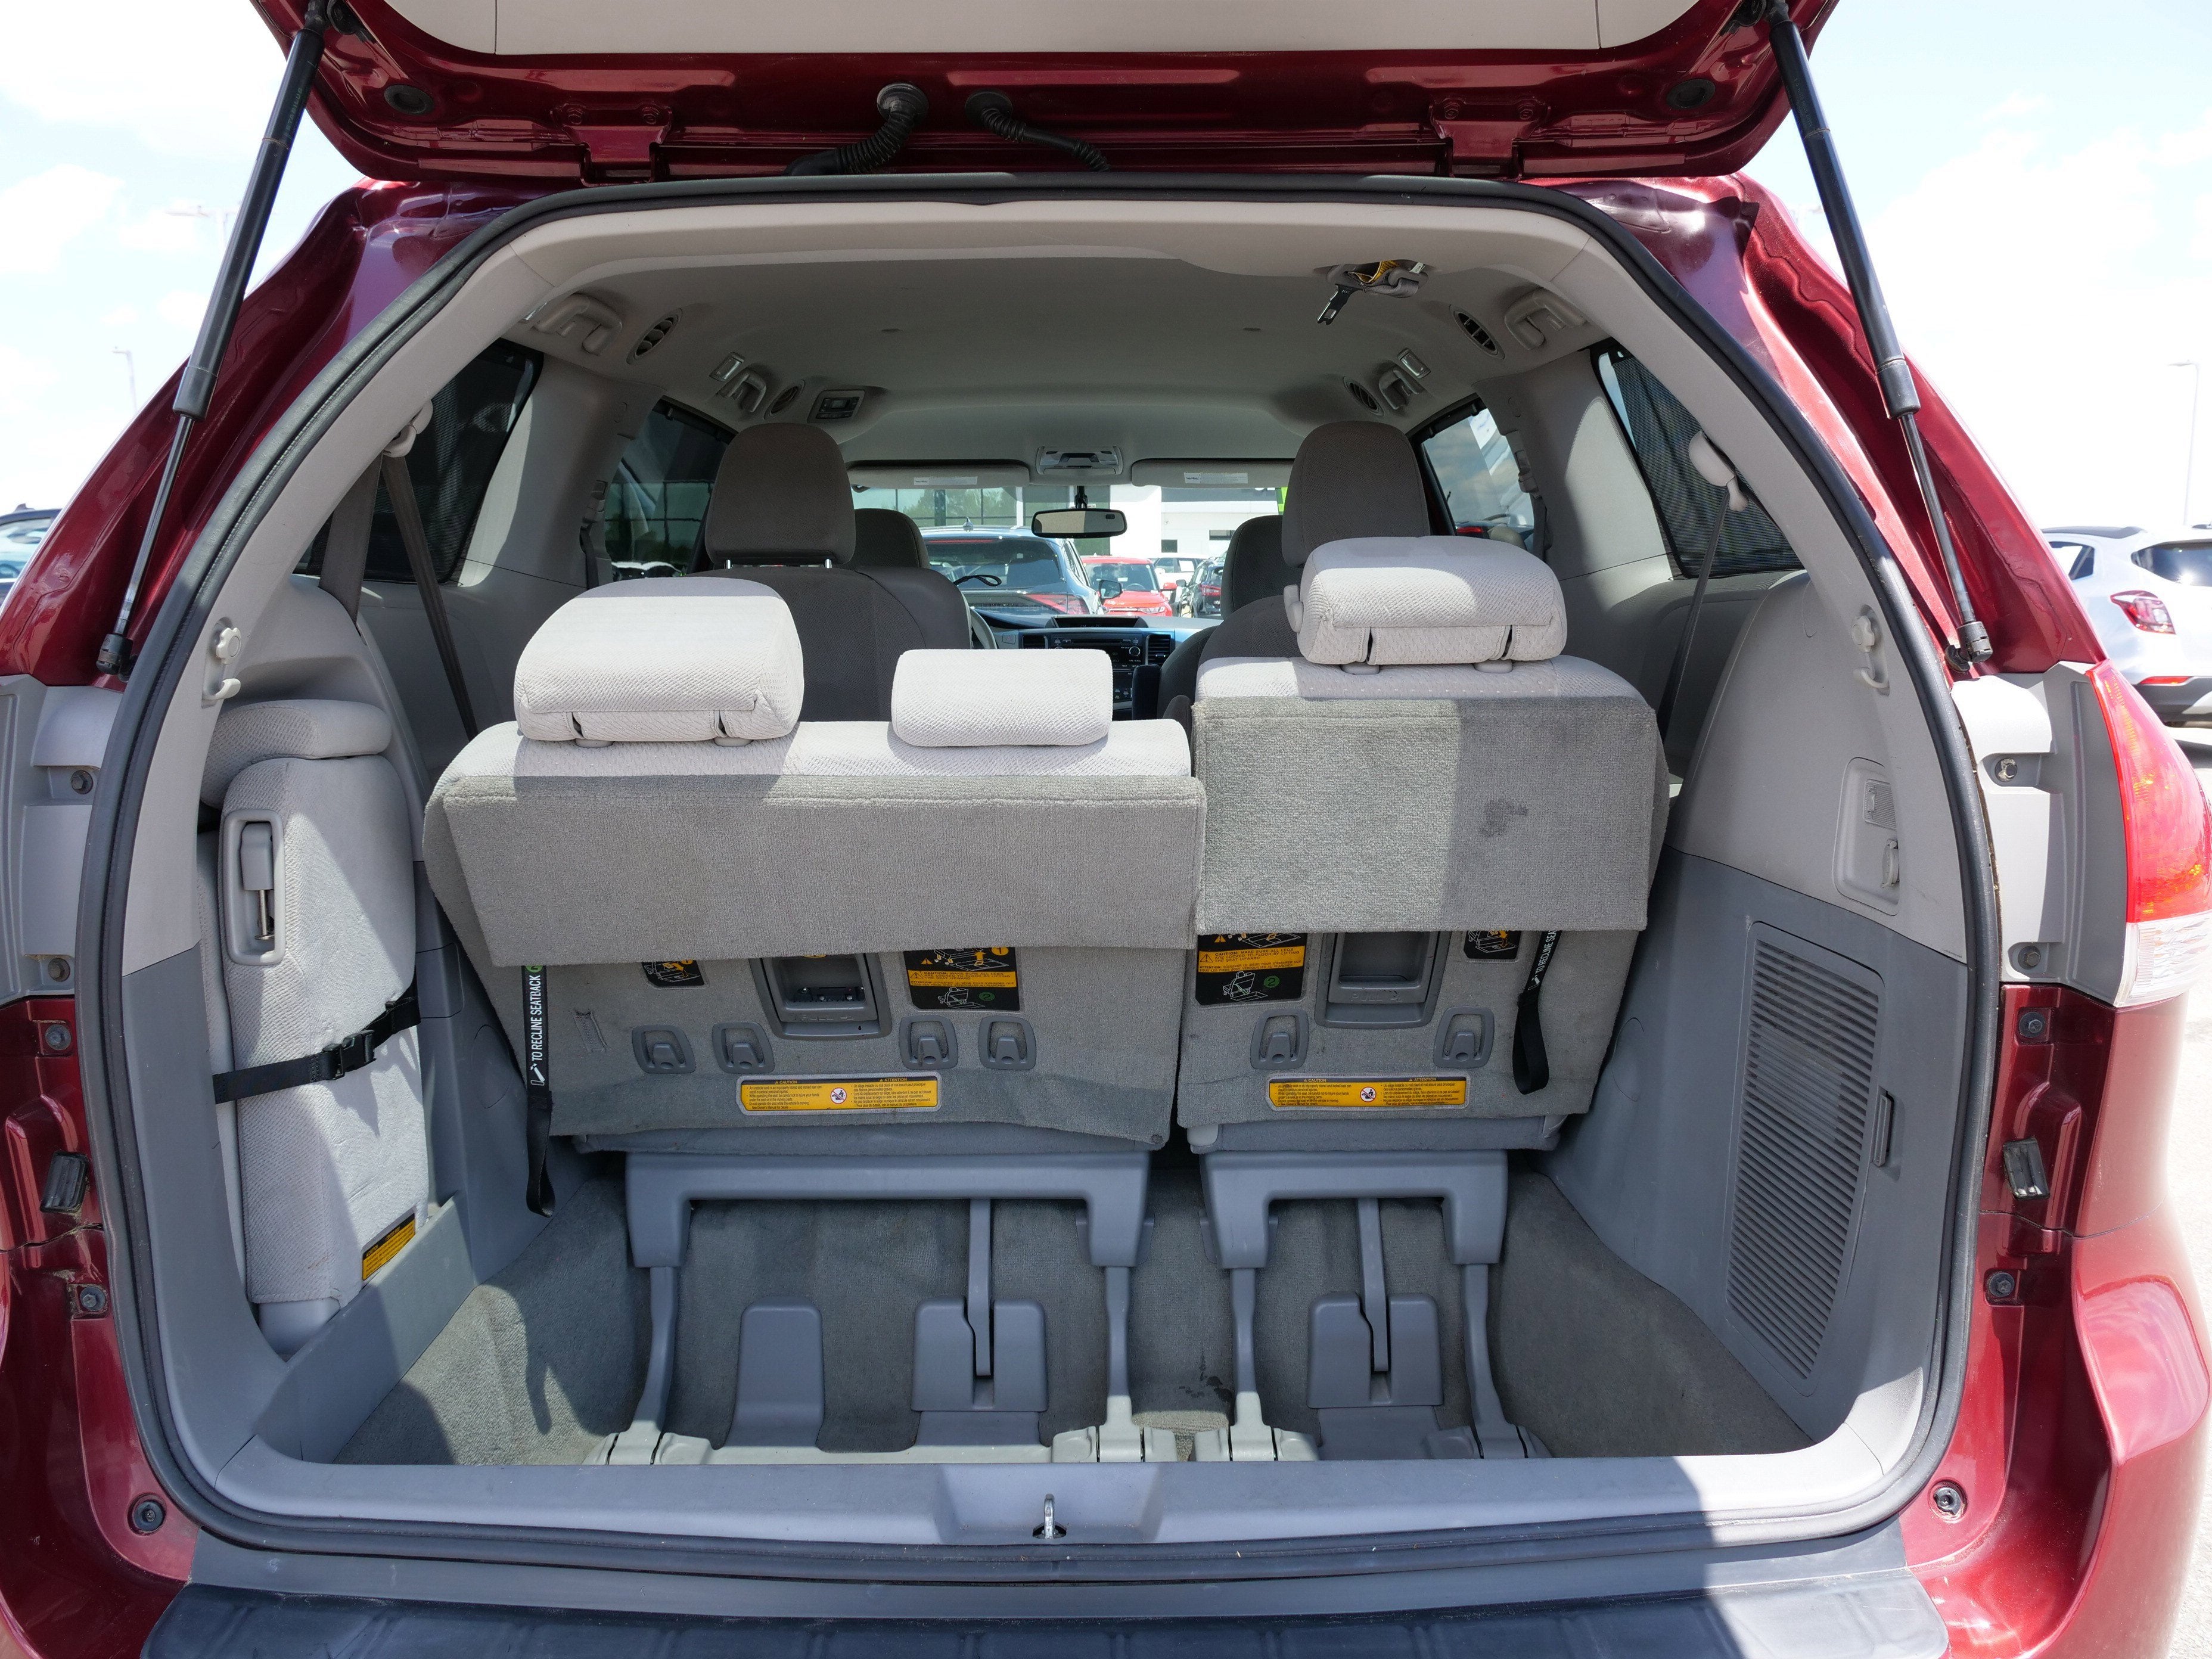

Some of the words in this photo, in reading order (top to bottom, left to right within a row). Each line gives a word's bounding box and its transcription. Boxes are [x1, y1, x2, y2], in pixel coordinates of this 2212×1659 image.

[1538, 942, 1554, 965] RECLINE
[1535, 965, 1545, 974] TO
[1267, 977, 1275, 986] 2
[529, 975, 542, 1015] SEATBACK
[530, 1017, 542, 1050] RECLINE
[532, 1052, 543, 1061] TO
